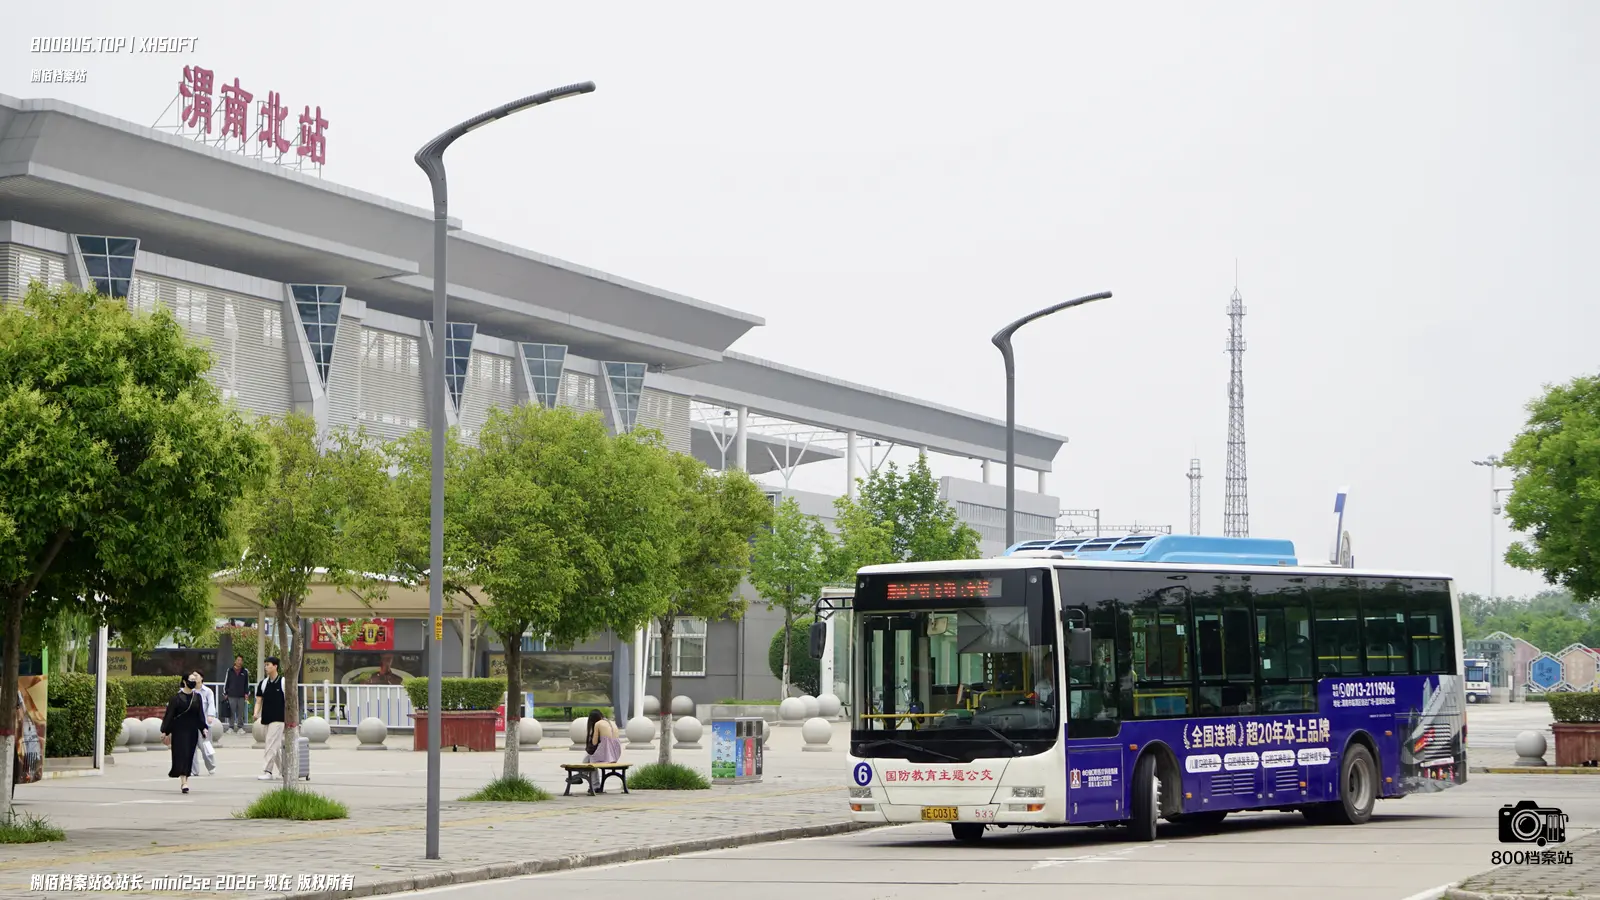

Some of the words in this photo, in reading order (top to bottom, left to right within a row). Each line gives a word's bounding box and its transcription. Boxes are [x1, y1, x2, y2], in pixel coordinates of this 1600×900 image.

[180, 65, 329, 165] 渭南北站
[1345, 681, 1395, 697] 0913-2119966
[1192, 724, 1237, 748] 全国连锁
[1246, 718, 1331, 746] 超20年本土品牌
[858, 765, 868, 783] 6
[885, 769, 994, 782] 国防教育主题公交
[975, 809, 994, 818] 533
